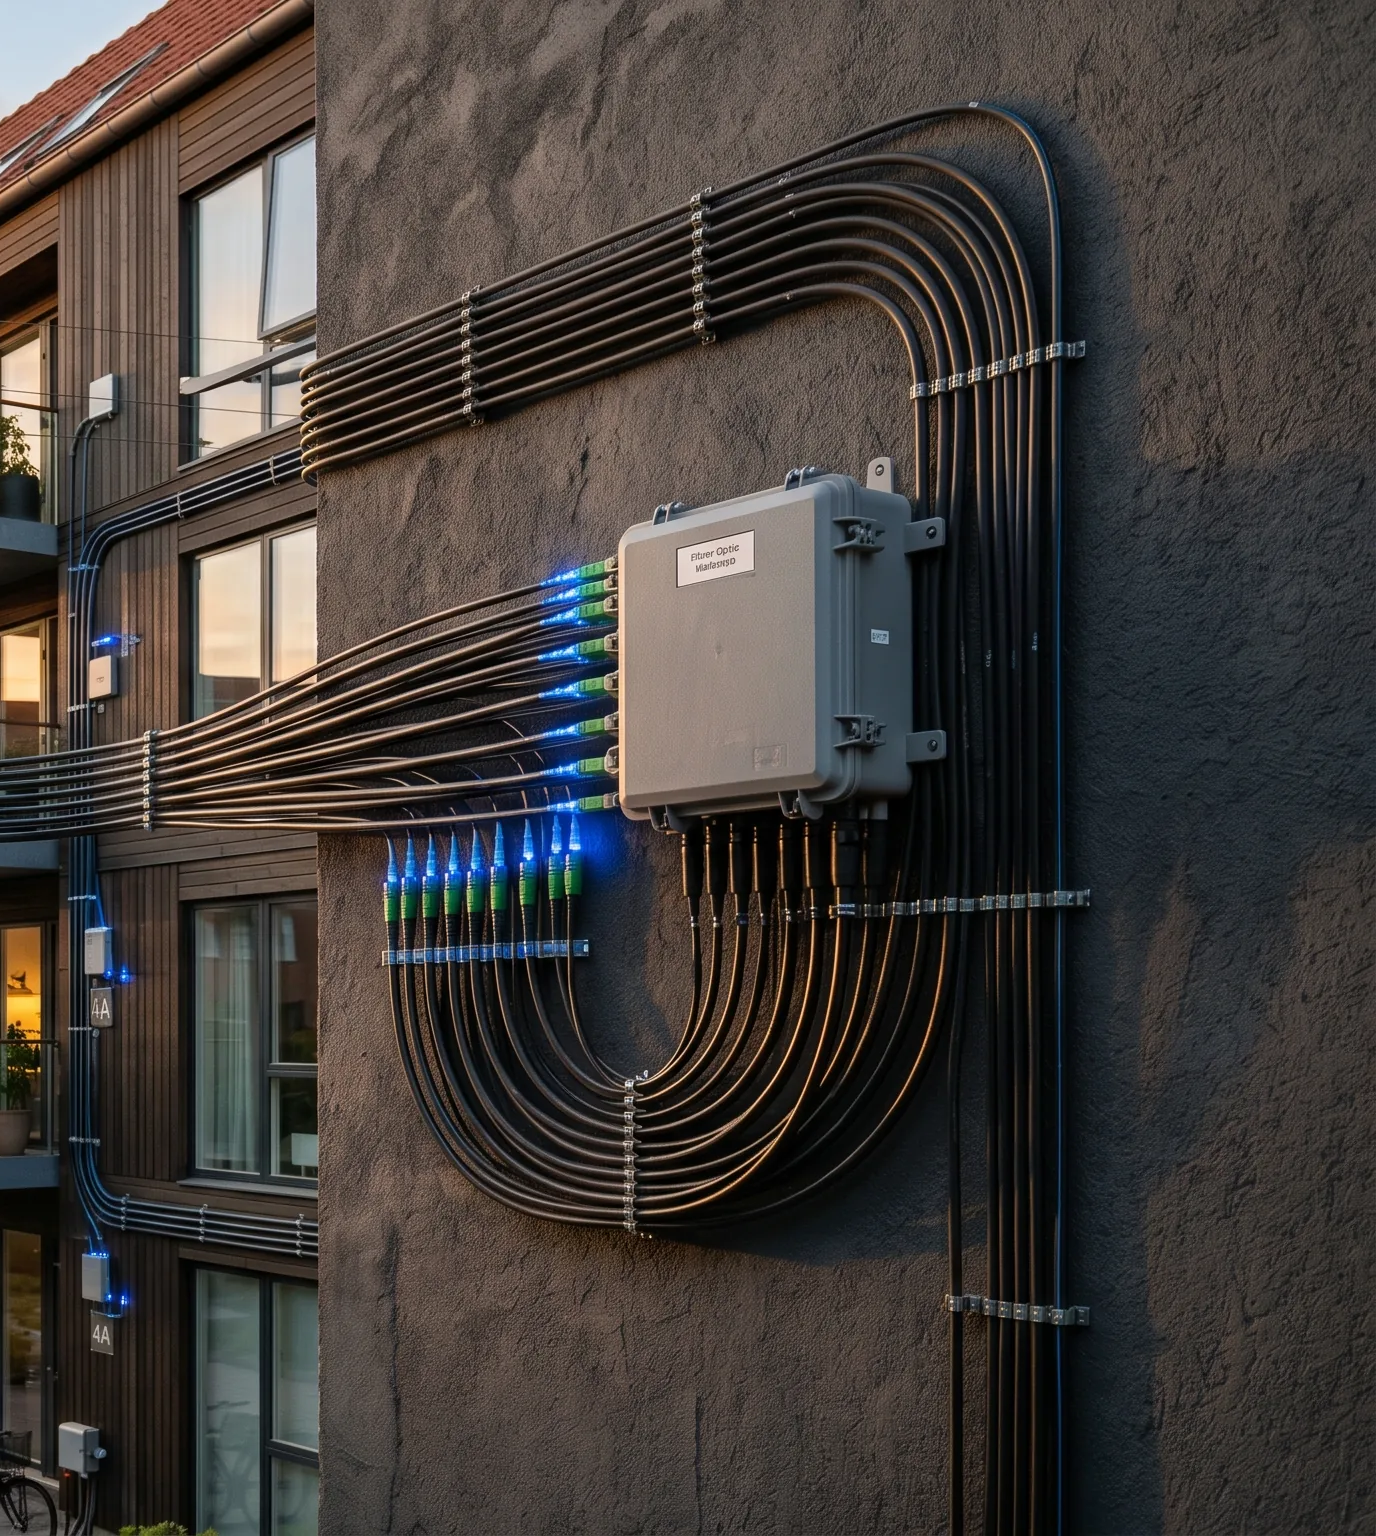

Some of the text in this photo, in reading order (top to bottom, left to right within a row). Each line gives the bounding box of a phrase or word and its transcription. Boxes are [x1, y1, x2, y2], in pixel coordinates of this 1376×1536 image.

[716, 543, 740, 556] Optic
[91, 998, 111, 1020] 4A
[92, 1324, 111, 1346] 4A
